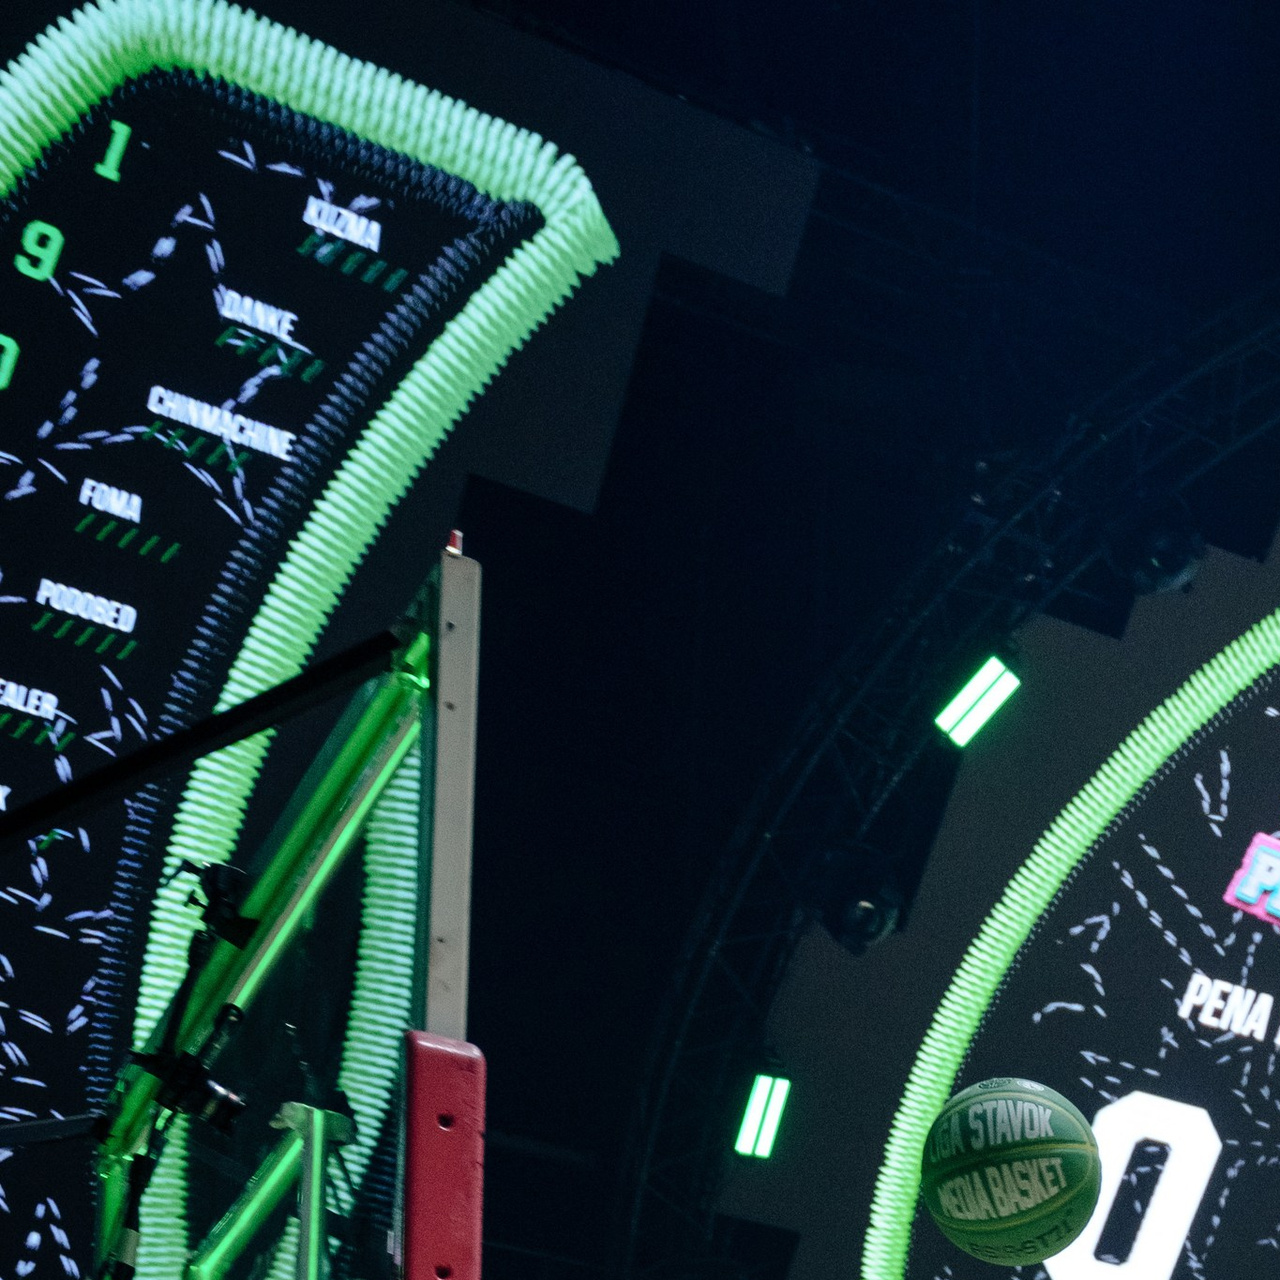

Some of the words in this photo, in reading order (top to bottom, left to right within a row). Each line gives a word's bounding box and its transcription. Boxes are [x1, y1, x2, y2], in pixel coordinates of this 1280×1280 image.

[14, 219, 65, 282] 9
[1177, 973, 1274, 1041] PENA
[968, 1099, 1054, 1150] STAVOK
[937, 1171, 998, 1221] MEDIA
[984, 1157, 1067, 1219] BASKET
